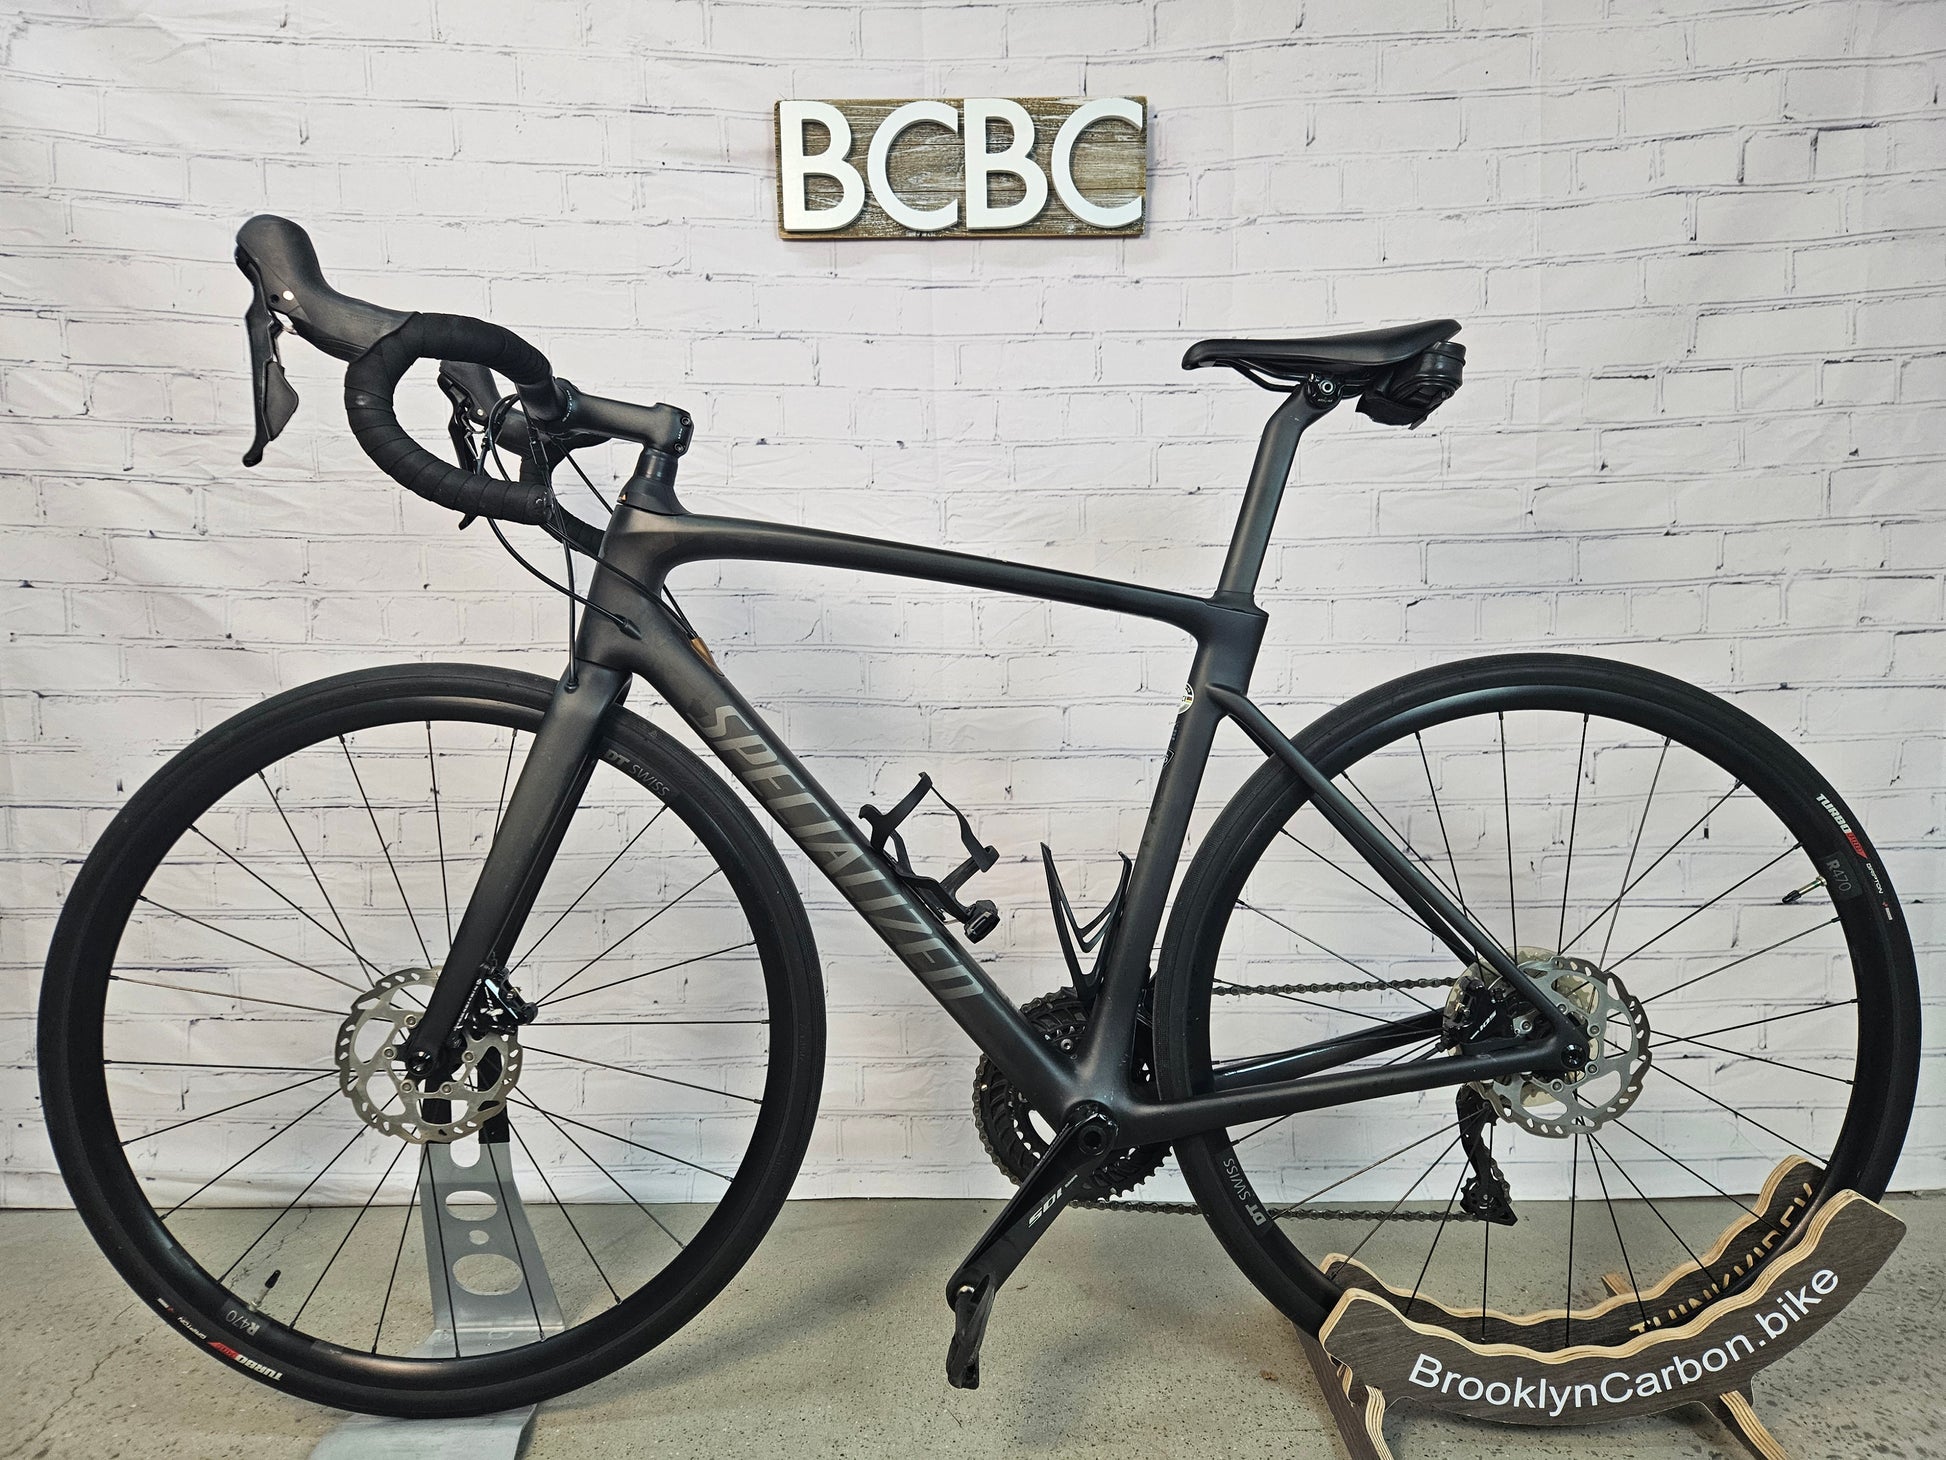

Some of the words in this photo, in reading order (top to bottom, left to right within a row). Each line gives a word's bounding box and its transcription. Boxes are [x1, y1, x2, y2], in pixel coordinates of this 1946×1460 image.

[779, 97, 1143, 231] BCBC
[604, 749, 630, 765] DT
[629, 764, 670, 796] SWISS
[1815, 793, 1853, 834] TURBO
[687, 704, 984, 999] SPECIALIZED
[1826, 860, 1852, 892] R470
[1222, 1157, 1252, 1201] SWISS
[1028, 1189, 1063, 1228] 105
[1244, 1203, 1268, 1227] DT
[225, 1309, 261, 1336] R470
[1408, 1268, 1839, 1417] BrooklynCarbon.bike
[235, 1353, 283, 1381] TURBO
